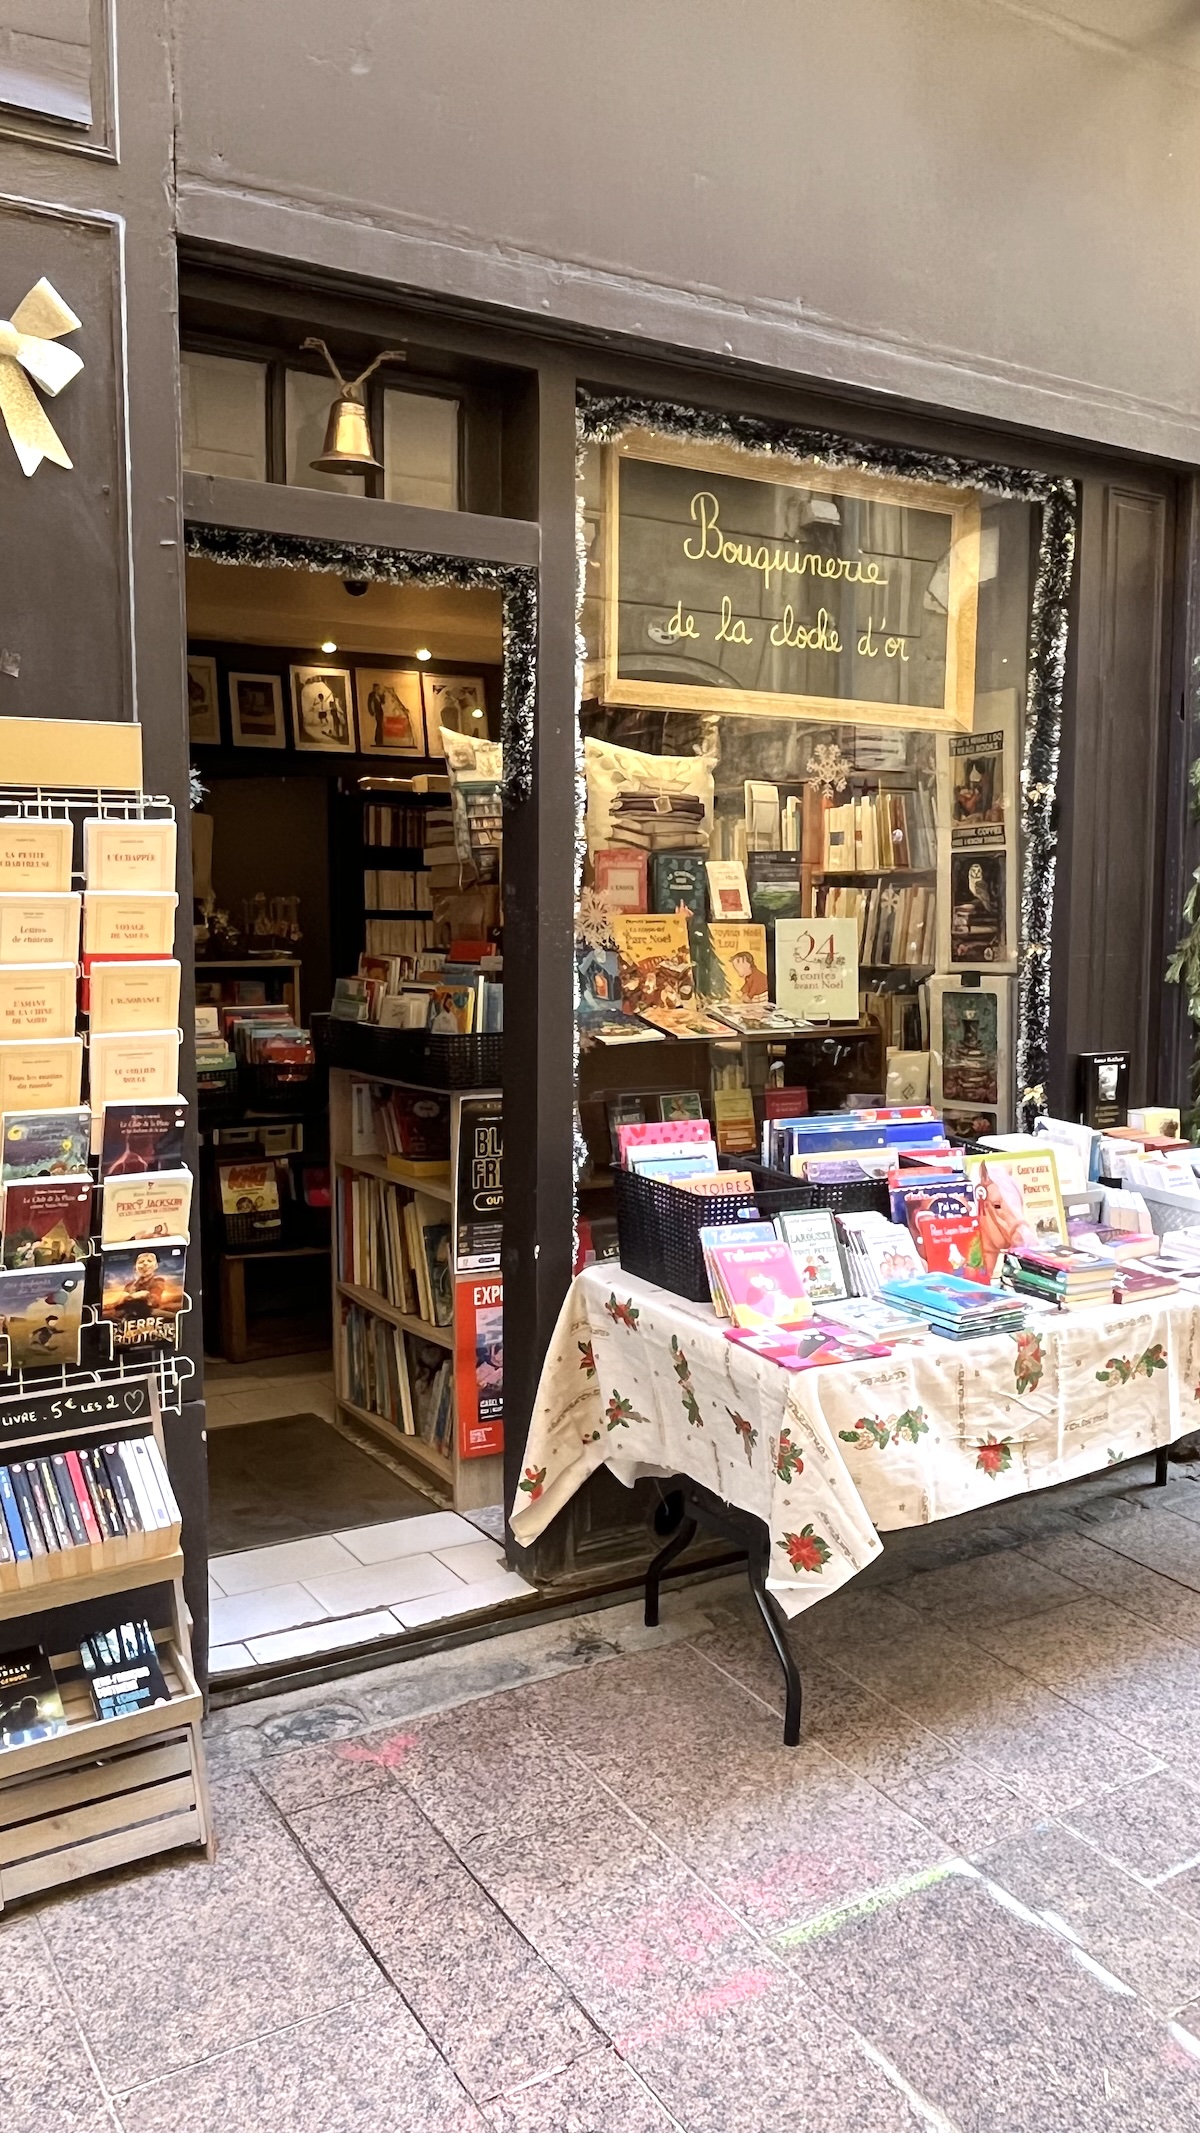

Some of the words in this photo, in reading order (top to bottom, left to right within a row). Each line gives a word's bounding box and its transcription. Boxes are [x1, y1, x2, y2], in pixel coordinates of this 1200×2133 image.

[684, 491, 888, 589] Bouquinerie
[667, 600, 700, 639] de
[715, 596, 753, 645] la
[770, 604, 843, 653] cloche
[857, 616, 909, 661] d'or
[797, 930, 840, 965] 24
[800, 973, 836, 981] contes
[821, 980, 844, 989] Noël
[475, 1127, 503, 1158] BL
[116, 1199, 144, 1211] PERCY
[145, 1198, 182, 1209] JACKSON
[2, 1411, 37, 1427] LIVRE
[81, 1402, 103, 1414] LES
[106, 1395, 119, 1410] 2
